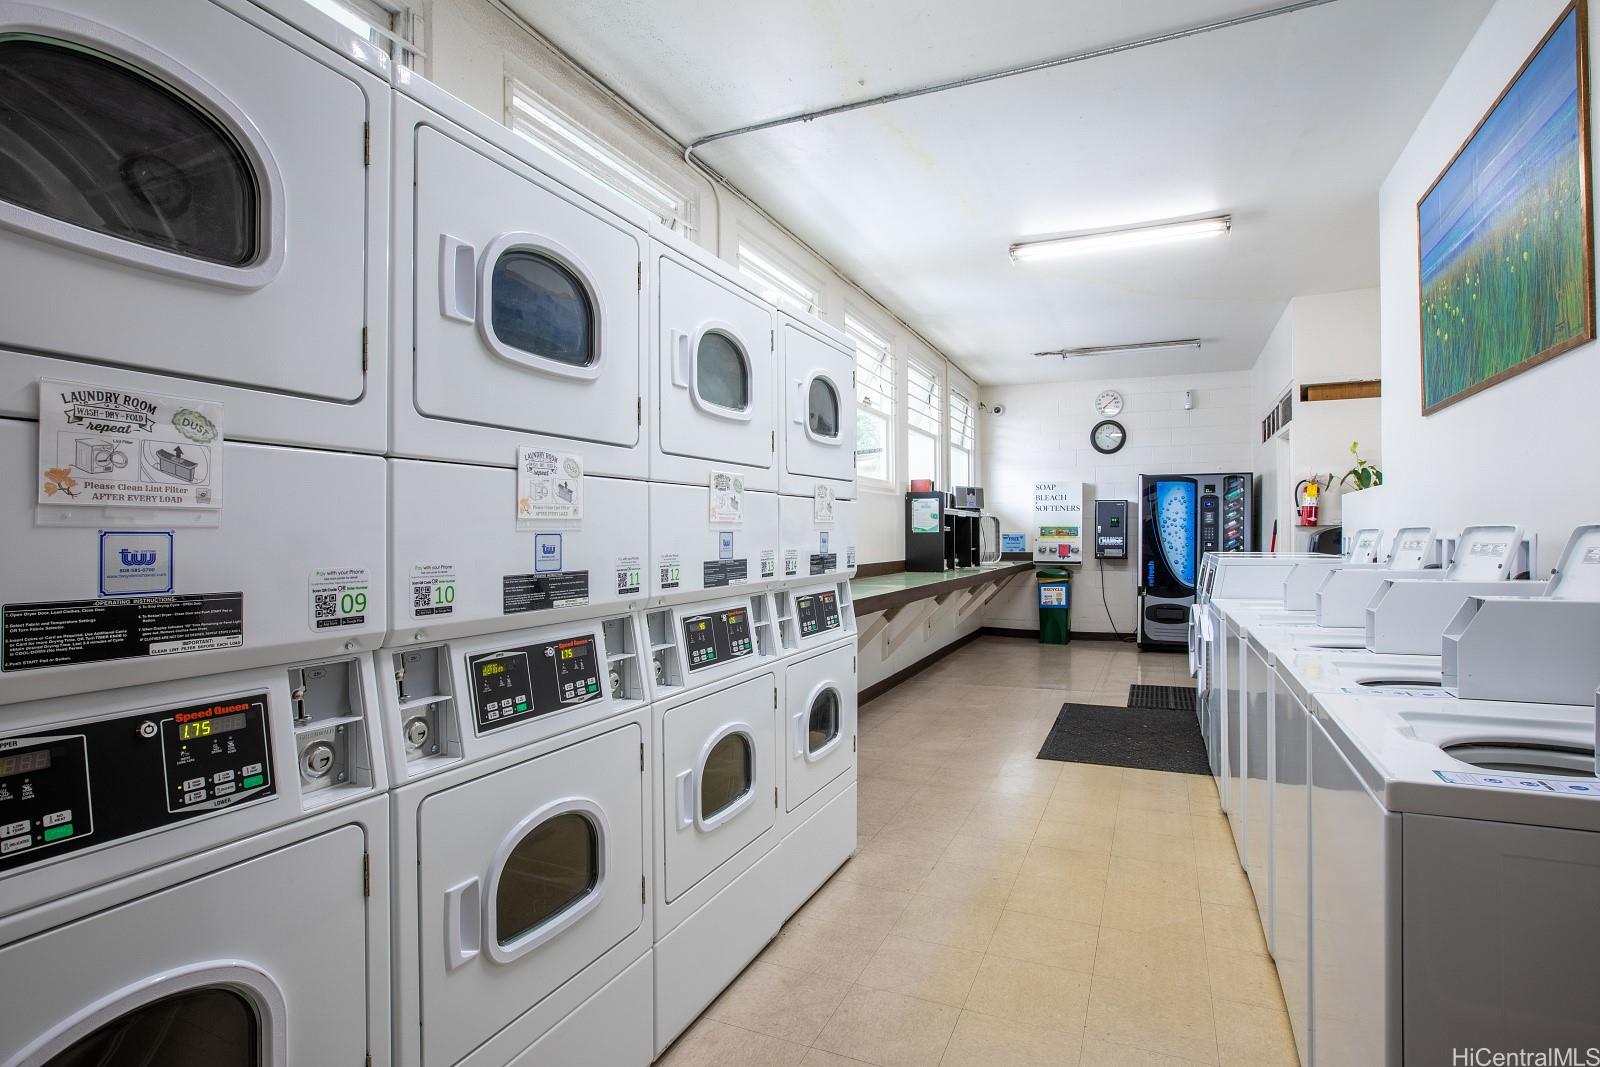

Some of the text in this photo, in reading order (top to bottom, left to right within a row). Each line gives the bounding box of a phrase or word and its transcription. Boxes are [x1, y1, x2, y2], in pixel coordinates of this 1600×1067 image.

[61, 390, 158, 414] LAUNDRY ROOM
[86, 422, 132, 434] repeat
[182, 418, 209, 436] DUST
[84, 482, 188, 494] Please Clean Lint Filter
[92, 492, 182, 504] AFTER EVERY LOAD
[1099, 536, 1123, 546] CHANGE
[768, 561, 774, 571] 13
[630, 572, 640, 586] 11
[670, 568, 680, 580] 12
[435, 586, 454, 604] 10
[342, 593, 366, 614] 09
[175, 703, 250, 722] Speed Queen
[184, 721, 210, 738] 1.75
[214, 798, 231, 806] LOWER
